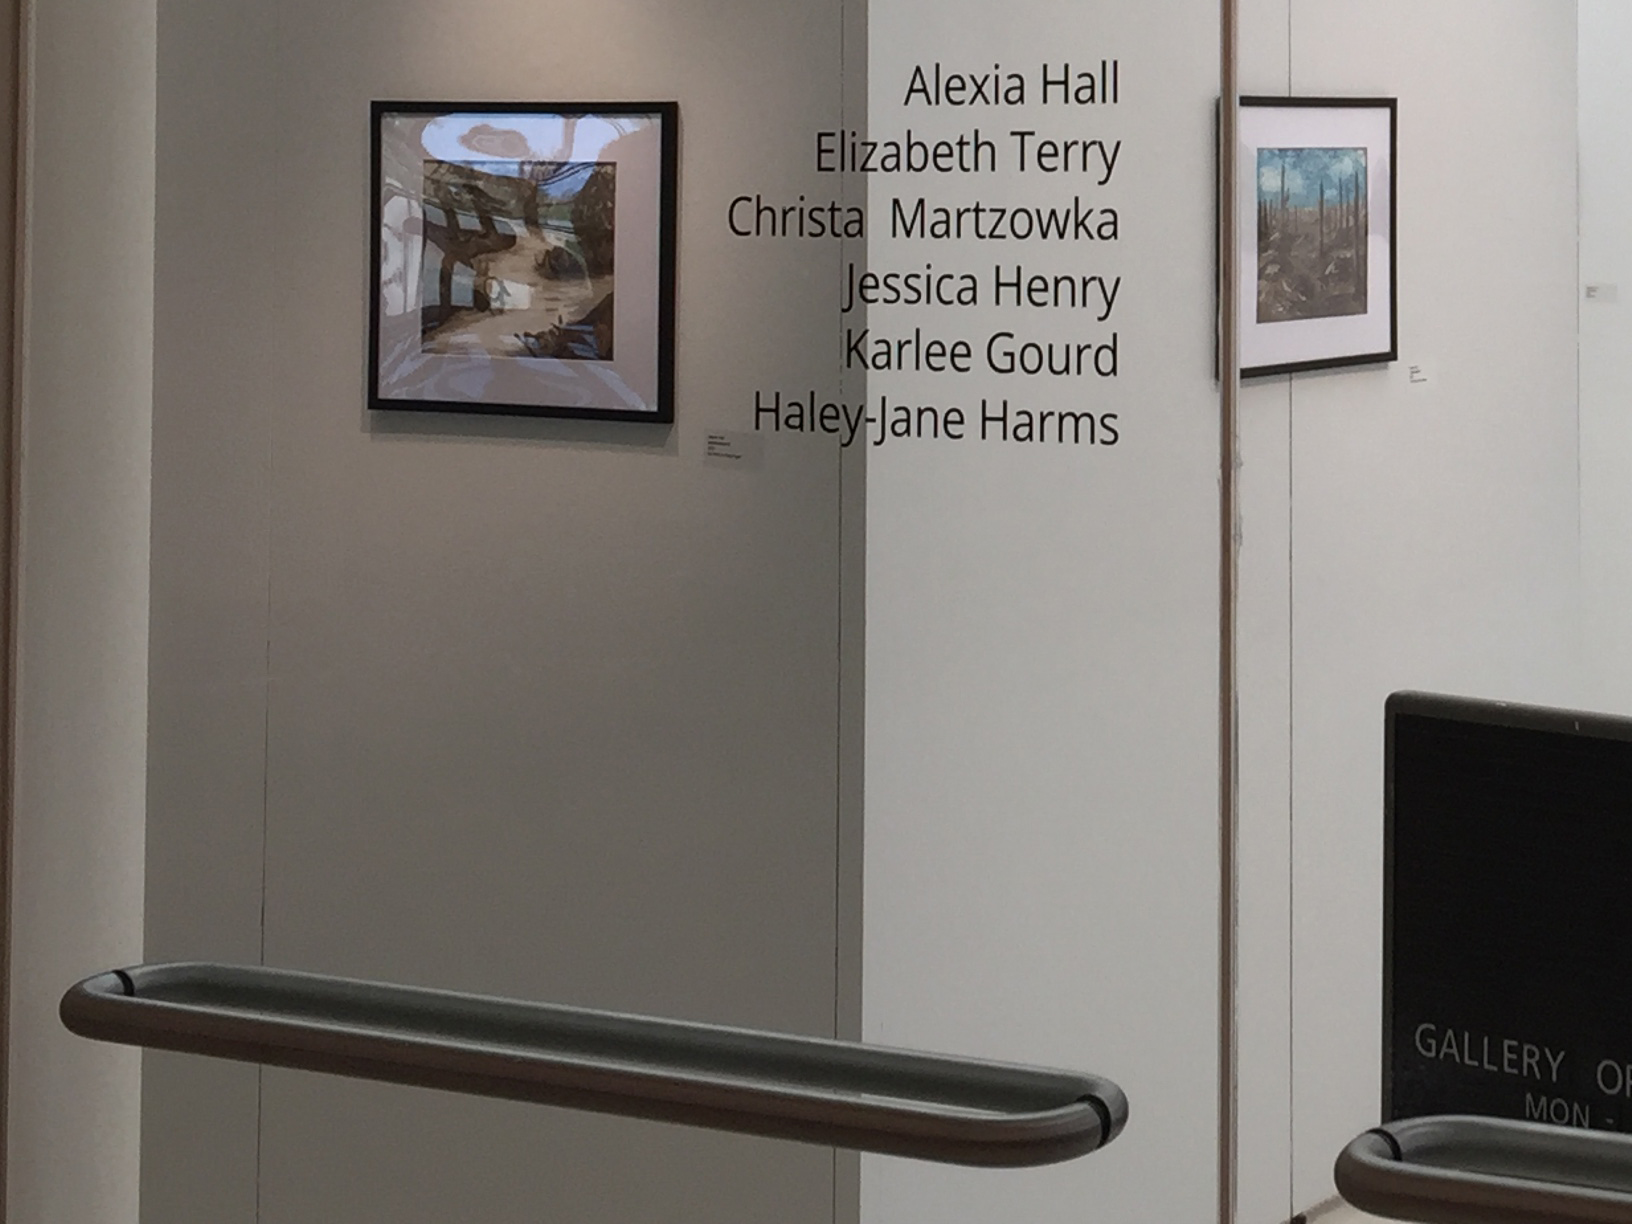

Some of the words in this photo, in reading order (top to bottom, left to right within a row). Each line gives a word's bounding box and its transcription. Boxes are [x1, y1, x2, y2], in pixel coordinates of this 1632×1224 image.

[903, 62, 1026, 107] Alexia
[1041, 59, 1120, 105] Hall
[815, 129, 997, 174] Elizabeth
[1009, 129, 1122, 186] Terry
[727, 195, 865, 239] Christa
[890, 195, 1120, 241] Martzowka
[840, 262, 978, 314] Jessica
[993, 264, 1122, 323] Henry
[845, 327, 972, 373] Karlee
[985, 331, 1120, 377] Gourd
[754, 390, 965, 448] Haley-Jane
[980, 398, 1120, 447] Harms
[1414, 1022, 1567, 1083] GALLERY
[1524, 1091, 1591, 1130] MON
